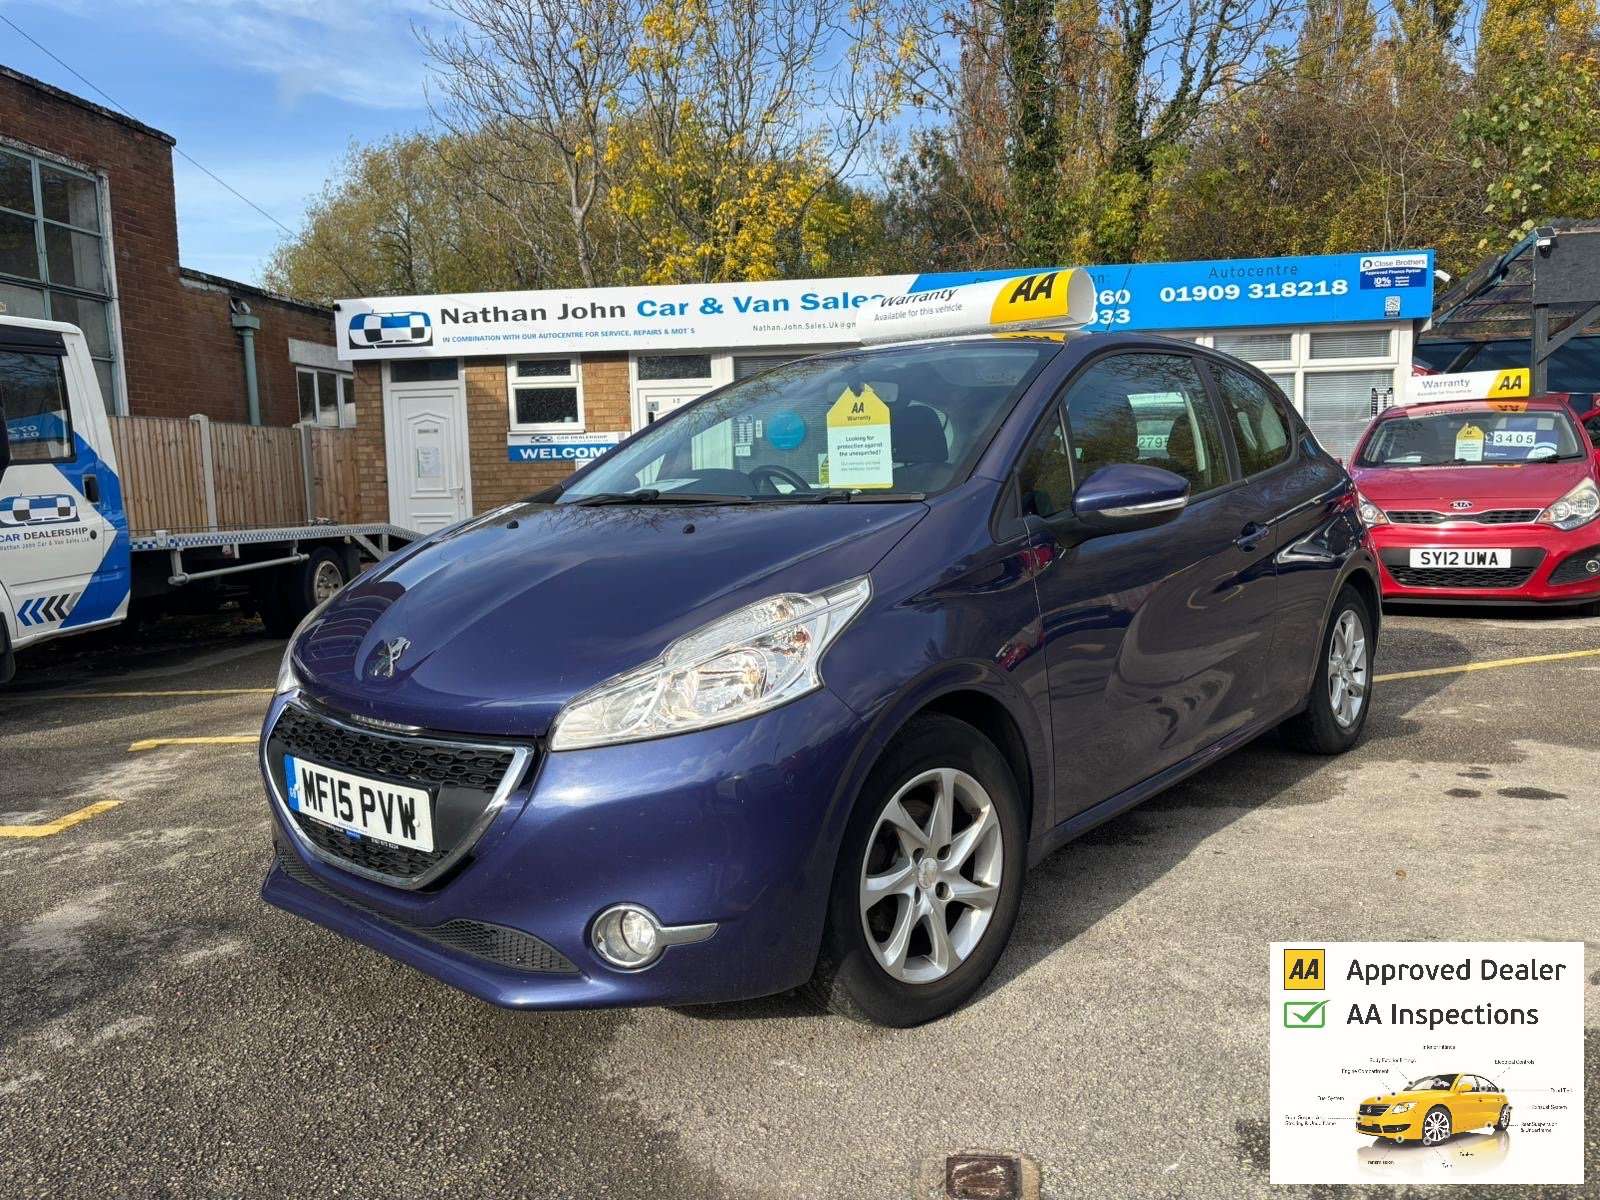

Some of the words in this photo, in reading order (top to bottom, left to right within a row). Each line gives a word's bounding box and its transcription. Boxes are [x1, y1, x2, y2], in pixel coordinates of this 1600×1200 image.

[1208, 264, 1298, 279] Autocentre
[1009, 272, 1060, 304] AA
[1159, 284, 1241, 302] 01909
[1247, 279, 1349, 298] 318218
[880, 289, 959, 308] Warranty
[440, 304, 547, 325] Nathan
[557, 302, 626, 320] John
[637, 299, 689, 318] Car
[699, 297, 724, 315] &
[733, 295, 790, 314] Van
[874, 311, 907, 322] Available
[907, 309, 919, 318] for
[919, 307, 934, 316] this
[934, 302, 964, 314] vehicle
[451, 335, 501, 343] COMBINATION
[1421, 378, 1471, 389] Warranty
[1498, 375, 1522, 391] AA
[851, 402, 865, 413] AA
[864, 441, 883, 449] against
[520, 446, 613, 460] WELCOM
[0, 533, 20, 542] CAR
[24, 527, 88, 541] DEALERSHIP
[1420, 551, 1459, 566] SY12
[1464, 551, 1499, 566] UWA
[301, 767, 355, 823] MF15
[358, 785, 416, 841] PVW
